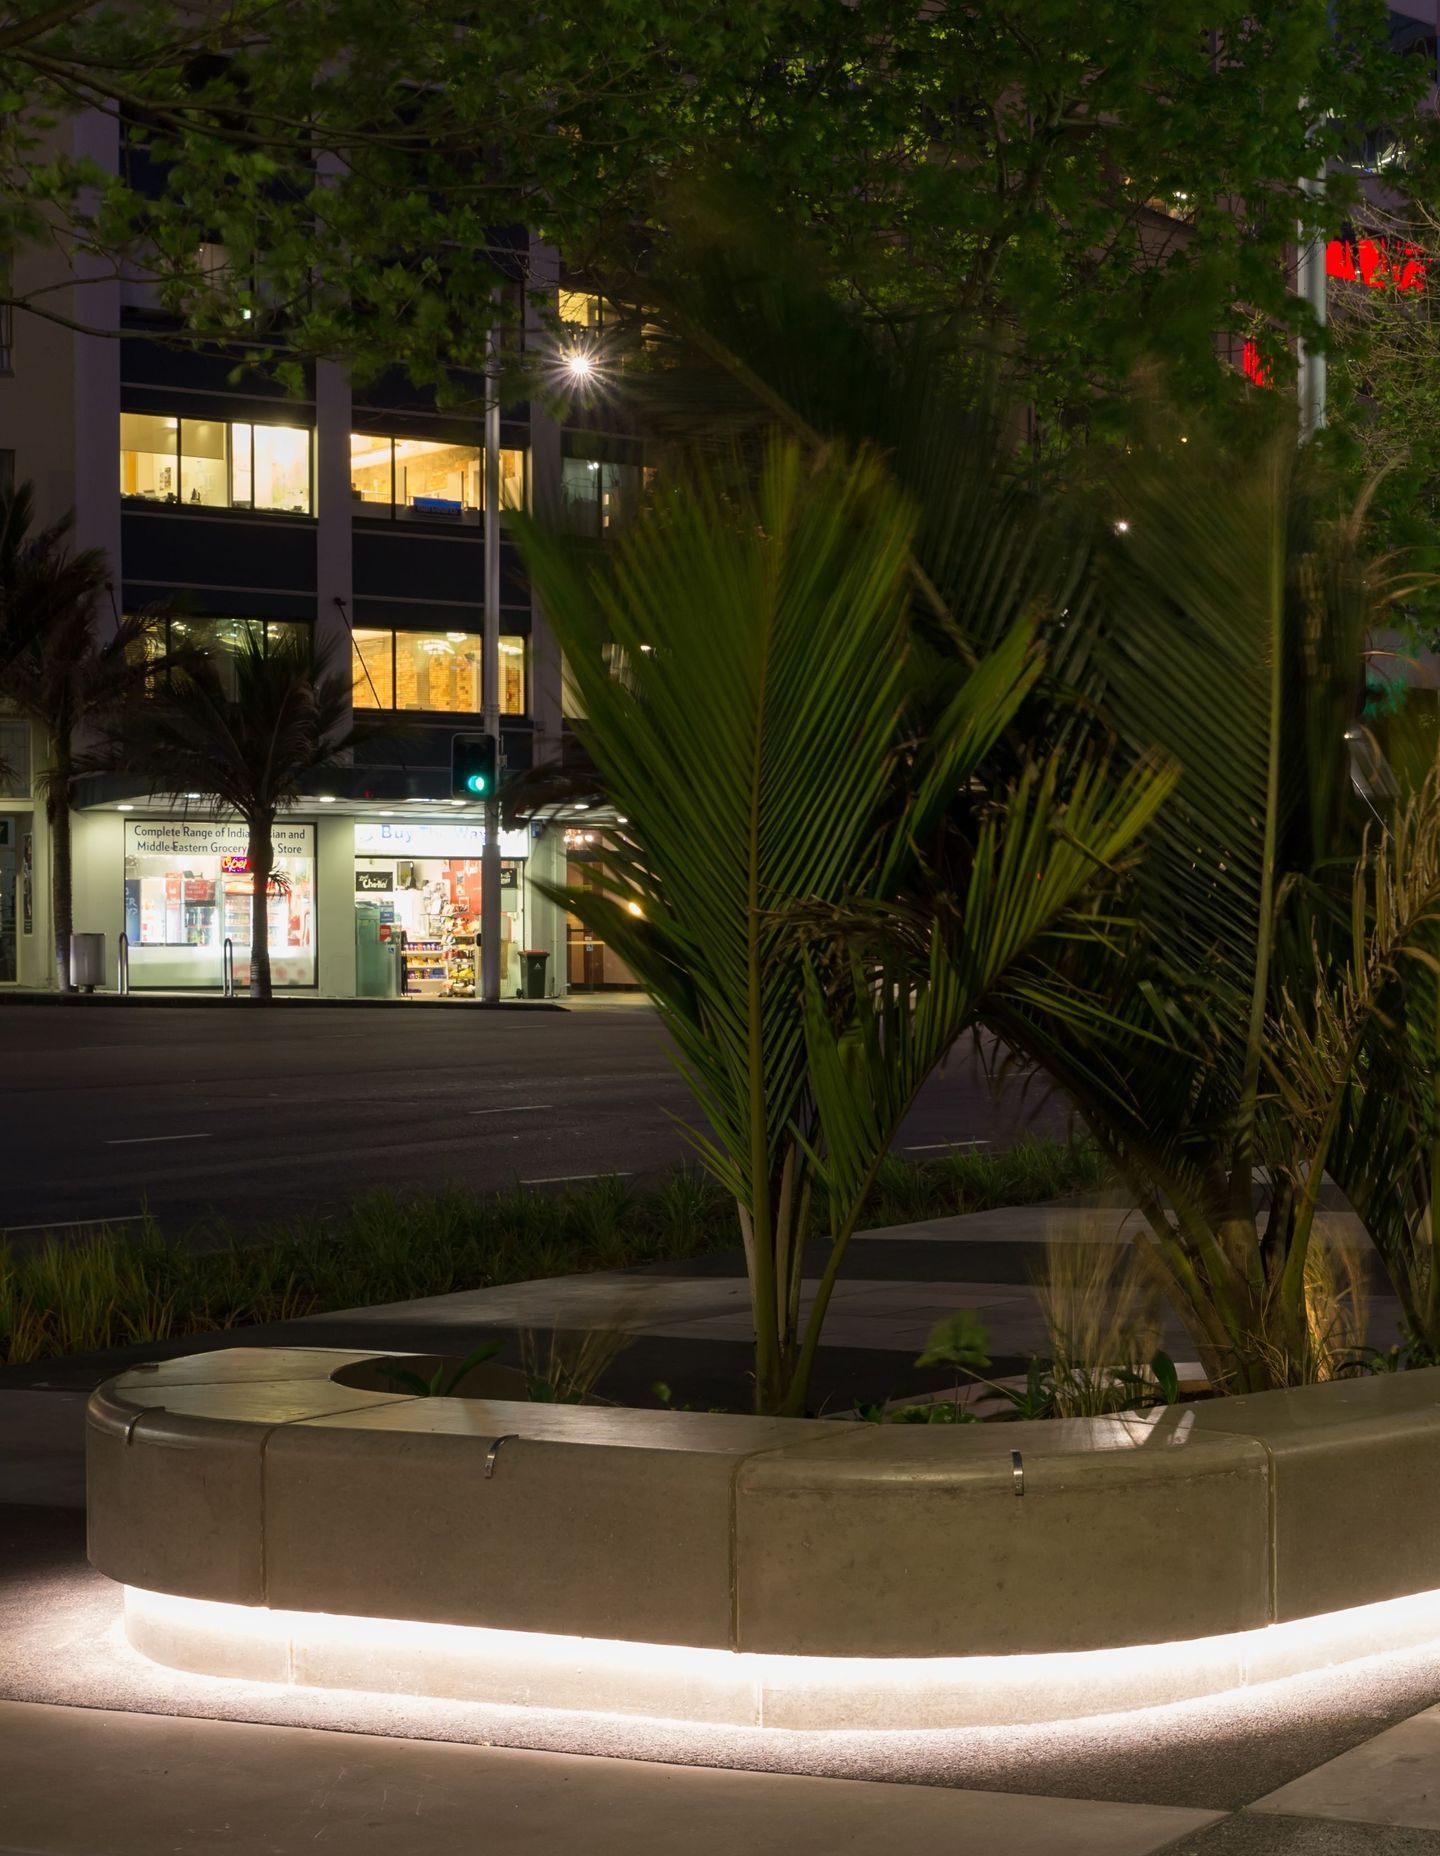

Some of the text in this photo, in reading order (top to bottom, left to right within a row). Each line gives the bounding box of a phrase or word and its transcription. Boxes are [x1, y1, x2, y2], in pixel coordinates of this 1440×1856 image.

[134, 825, 180, 838] Complete
[183, 826, 213, 840] Range
[215, 827, 227, 838] of
[228, 827, 249, 838] India
[288, 829, 305, 839] and
[381, 824, 413, 843] Buy
[137, 841, 170, 852] Middle
[172, 842, 208, 853] Eastern
[210, 842, 247, 855] Grocery
[277, 843, 302, 854] Store
